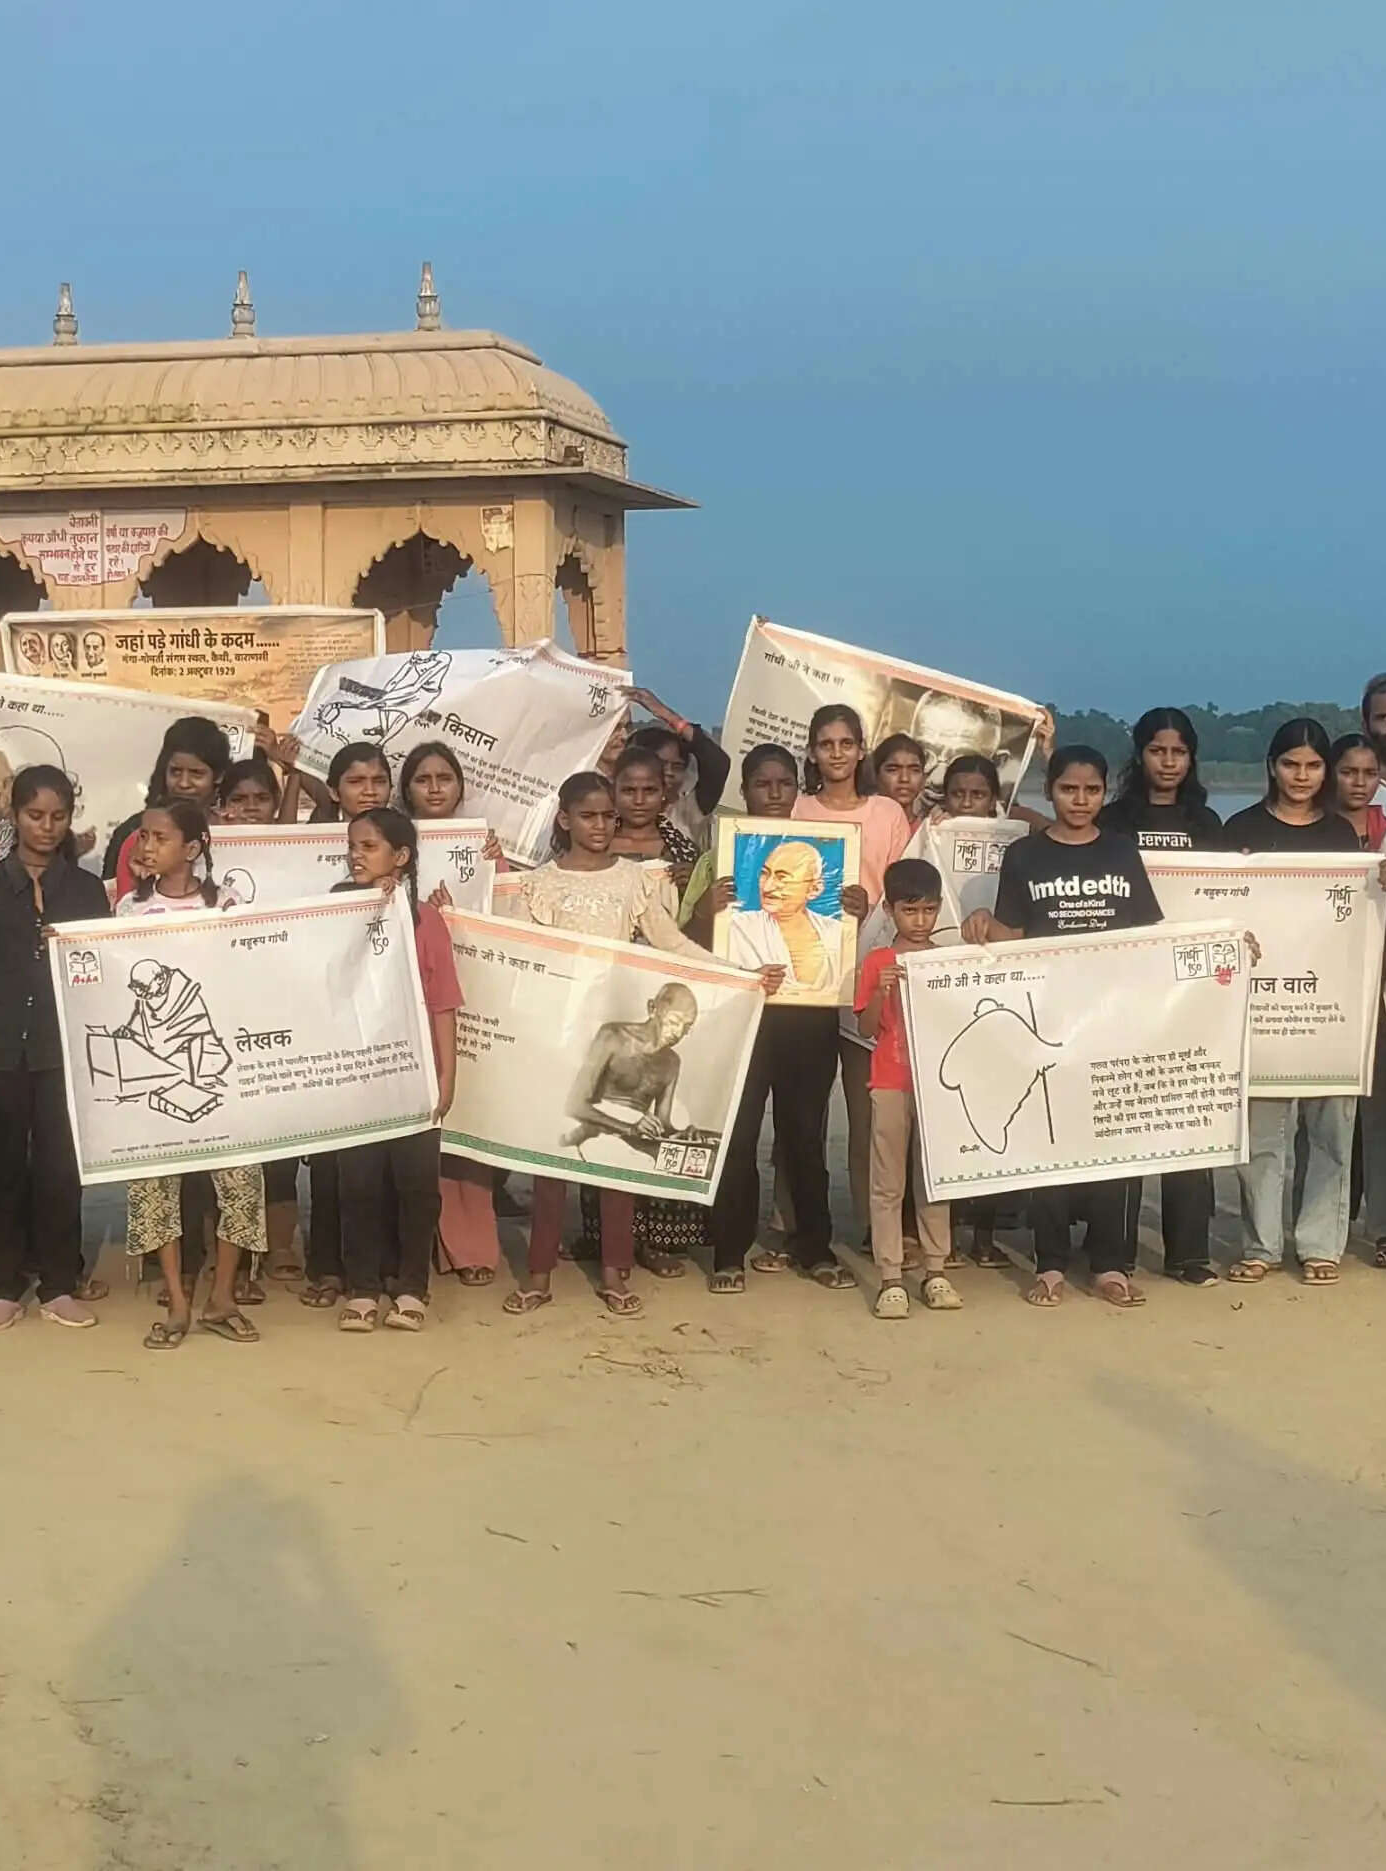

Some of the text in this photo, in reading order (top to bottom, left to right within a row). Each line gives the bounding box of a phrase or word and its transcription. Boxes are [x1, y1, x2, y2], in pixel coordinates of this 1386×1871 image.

[115, 630, 144, 650] जहां
[170, 628, 201, 650] गांधी
[203, 627, 217, 649] के
[165, 652, 186, 664] संगम
[764, 651, 785, 667] गांधी
[179, 667, 184, 676] 2
[215, 665, 236, 677] 1929
[8, 701, 29, 713] कहा
[442, 712, 498, 751] किसान
[1137, 831, 1192, 848] Ferrari
[446, 845, 478, 868] गांधी
[1203, 887, 1228, 900] बहुरूप
[1230, 886, 1250, 897] गांधी
[1325, 884, 1357, 907] गांधी
[1088, 899, 1106, 908] Kind
[1048, 908, 1116, 919] NO SECOND CHANCES
[231, 930, 289, 951] # बहुरूप गांधी
[481, 949, 494, 962] जी
[497, 952, 506, 965] ने
[509, 956, 529, 971] कहा
[533, 963, 546, 974] था
[1176, 946, 1204, 965] गांधी
[926, 975, 951, 990] गांधी
[955, 974, 969, 989] जी
[972, 972, 981, 986] ने
[984, 971, 1005, 986] कहा
[1282, 970, 1319, 994] वाले
[234, 1028, 292, 1052] लेखक
[1132, 1055, 1140, 1064] के
[1193, 1046, 1207, 1057] और
[1117, 1069, 1132, 1080] लोग
[1158, 1065, 1165, 1075] के
[1107, 1087, 1119, 1098] लूट
[1122, 1085, 1131, 1095] रहे
[1157, 1080, 1167, 1089] कि
[1178, 1078, 1188, 1087] इस
[1218, 1072, 1226, 1081] ही
[1093, 1100, 1106, 1111] और
[1185, 1090, 1198, 1101] नहीं
[1200, 1088, 1215, 1099] होनी
[1114, 1112, 1124, 1122] की
[1126, 1112, 1137, 1122] इस
[1139, 1110, 1152, 1120] दशा
[1155, 1108, 1163, 1117] के
[1187, 1104, 1195, 1114] ही
[1197, 1102, 1213, 1113] हमारे
[1175, 1120, 1185, 1131] रह
[1186, 1118, 1201, 1130] जाते
